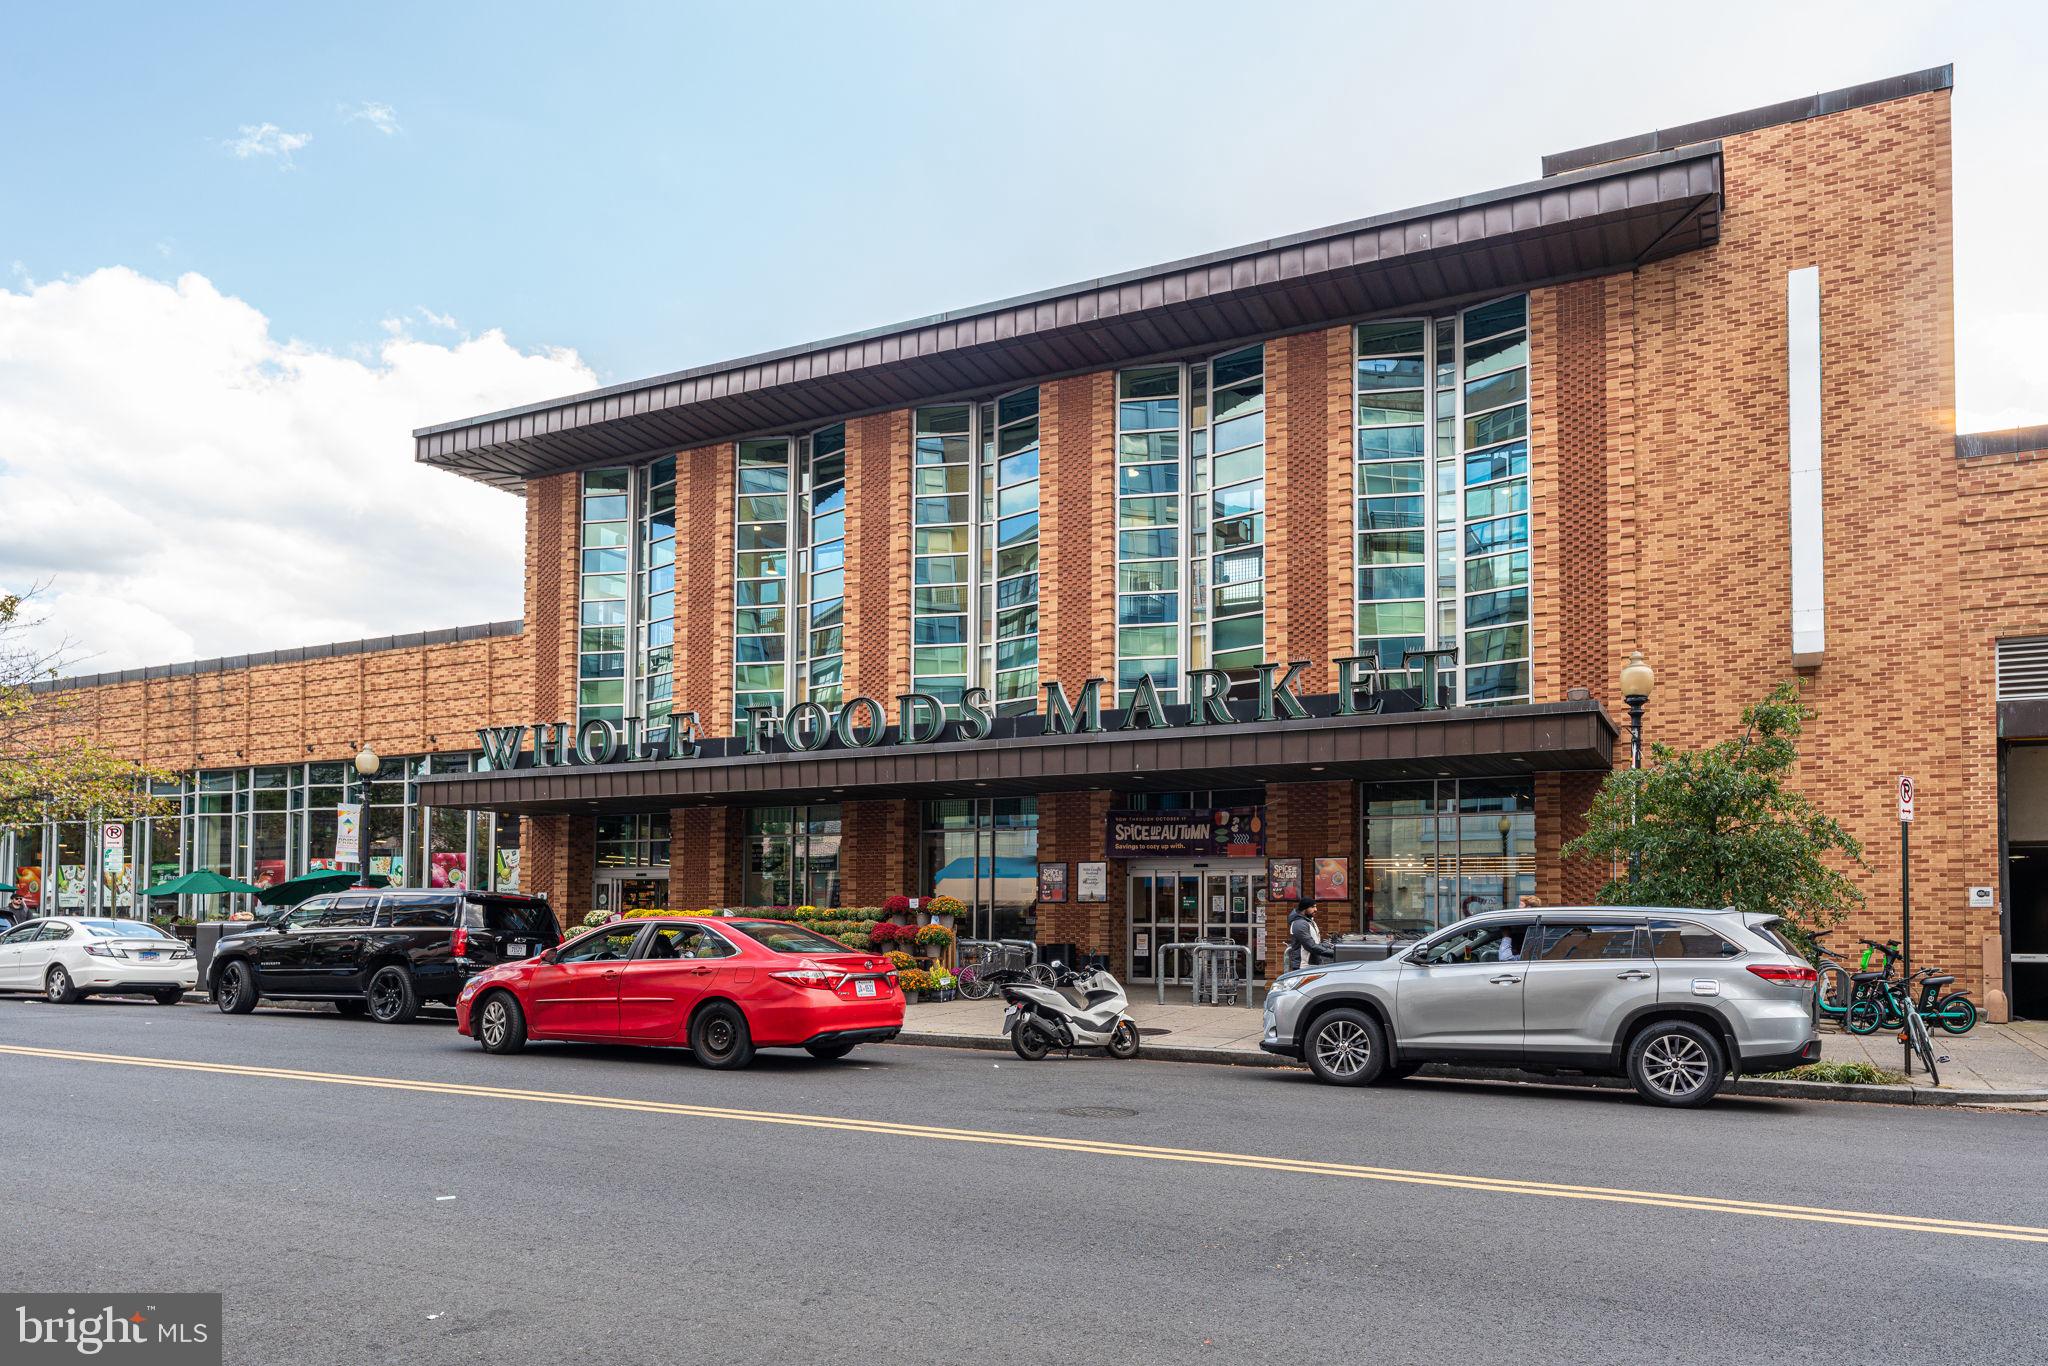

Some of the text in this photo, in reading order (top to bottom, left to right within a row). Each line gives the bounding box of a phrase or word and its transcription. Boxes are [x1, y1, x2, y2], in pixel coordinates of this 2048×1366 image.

[477, 647, 1460, 770] WHOLE FOODS MARKET
[1151, 826, 1161, 836] UP
[1926, 989, 1937, 1008] veo
